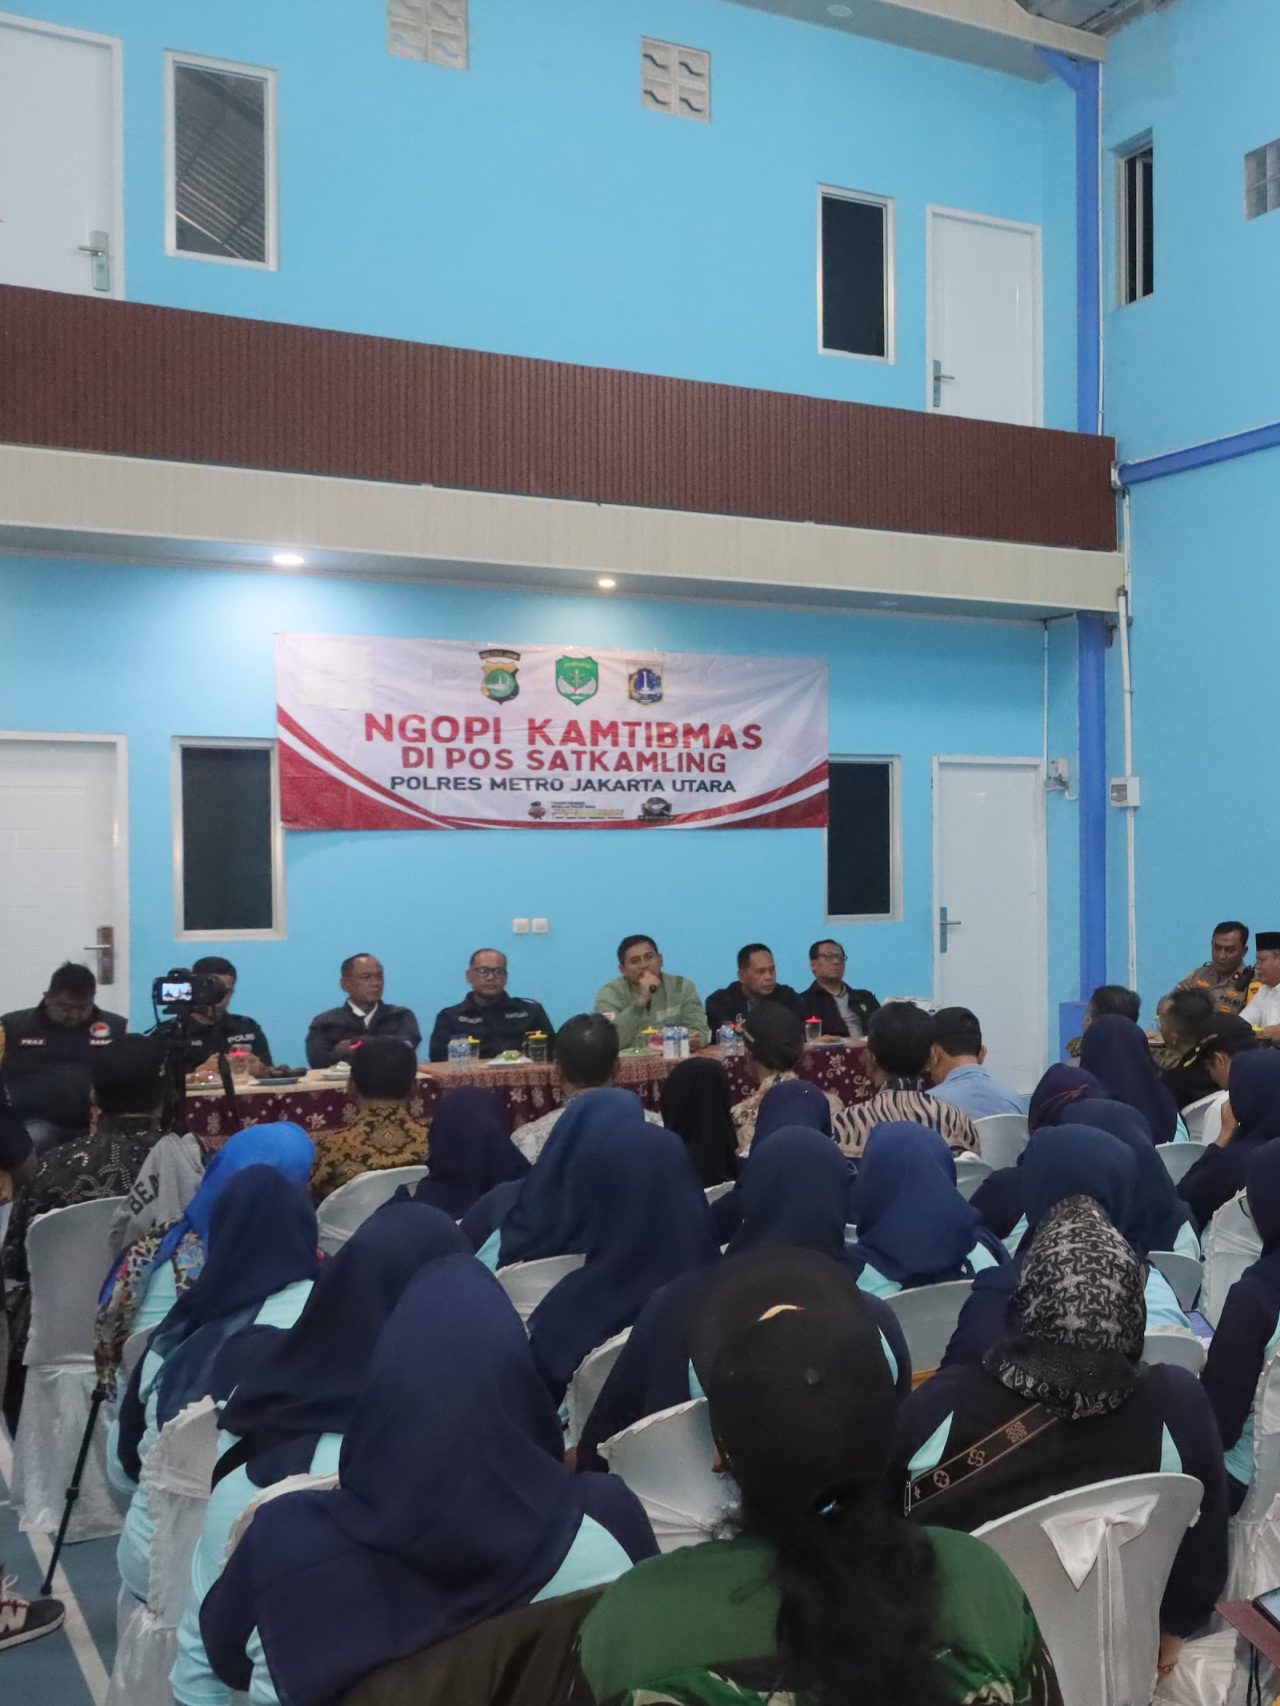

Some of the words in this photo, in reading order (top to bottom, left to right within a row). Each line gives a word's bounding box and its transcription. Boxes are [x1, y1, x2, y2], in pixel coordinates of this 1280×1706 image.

[364, 712, 501, 745] NGOPI
[527, 717, 763, 750] KAMTIBMAS
[401, 746, 434, 769] DI
[445, 747, 514, 770] POS
[526, 749, 726, 773] SATKAMLING
[390, 776, 482, 791] POLRES
[490, 777, 564, 792] METRO
[570, 778, 665, 792] JAKARTA
[672, 779, 737, 793] UTARA
